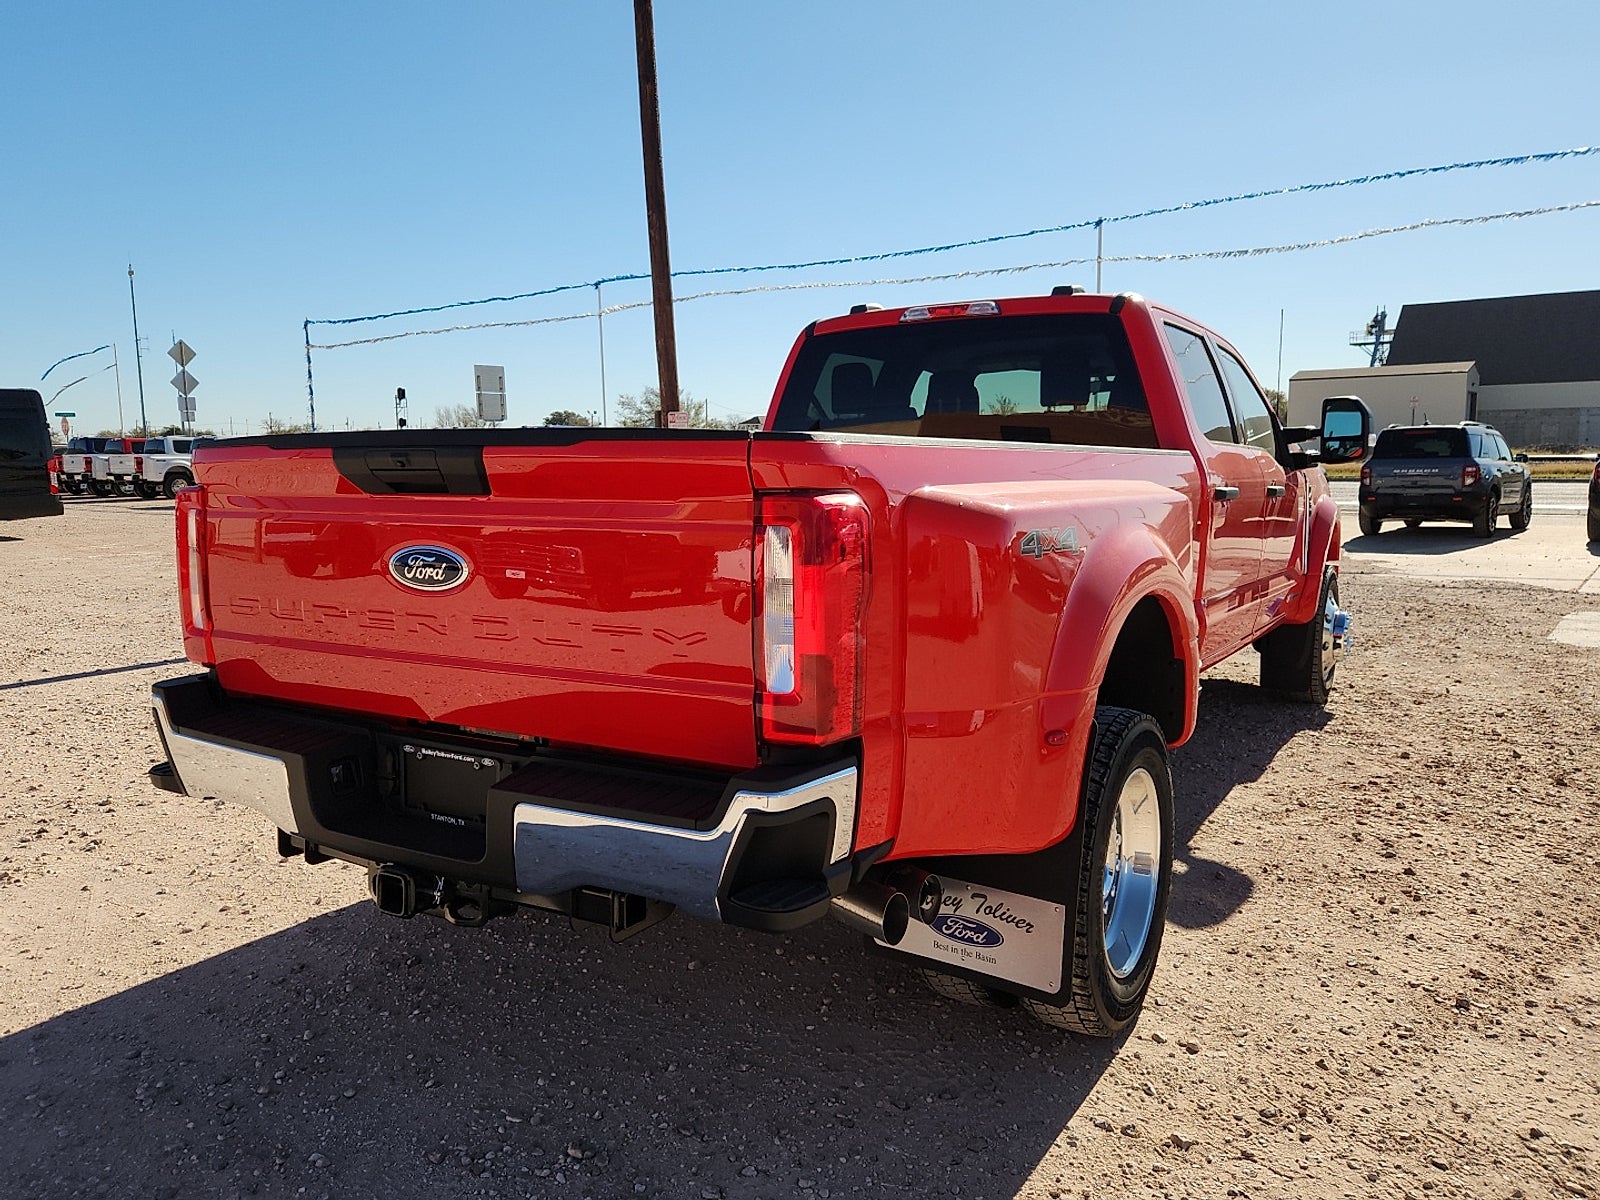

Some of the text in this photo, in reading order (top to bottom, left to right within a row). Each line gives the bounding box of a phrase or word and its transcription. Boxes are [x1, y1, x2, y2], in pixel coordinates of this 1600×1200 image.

[229, 596, 709, 658] SUPER DUTY
[970, 892, 1035, 933] Toliver
[942, 917, 989, 944] Ford
[933, 940, 997, 964] Best in the Basin
